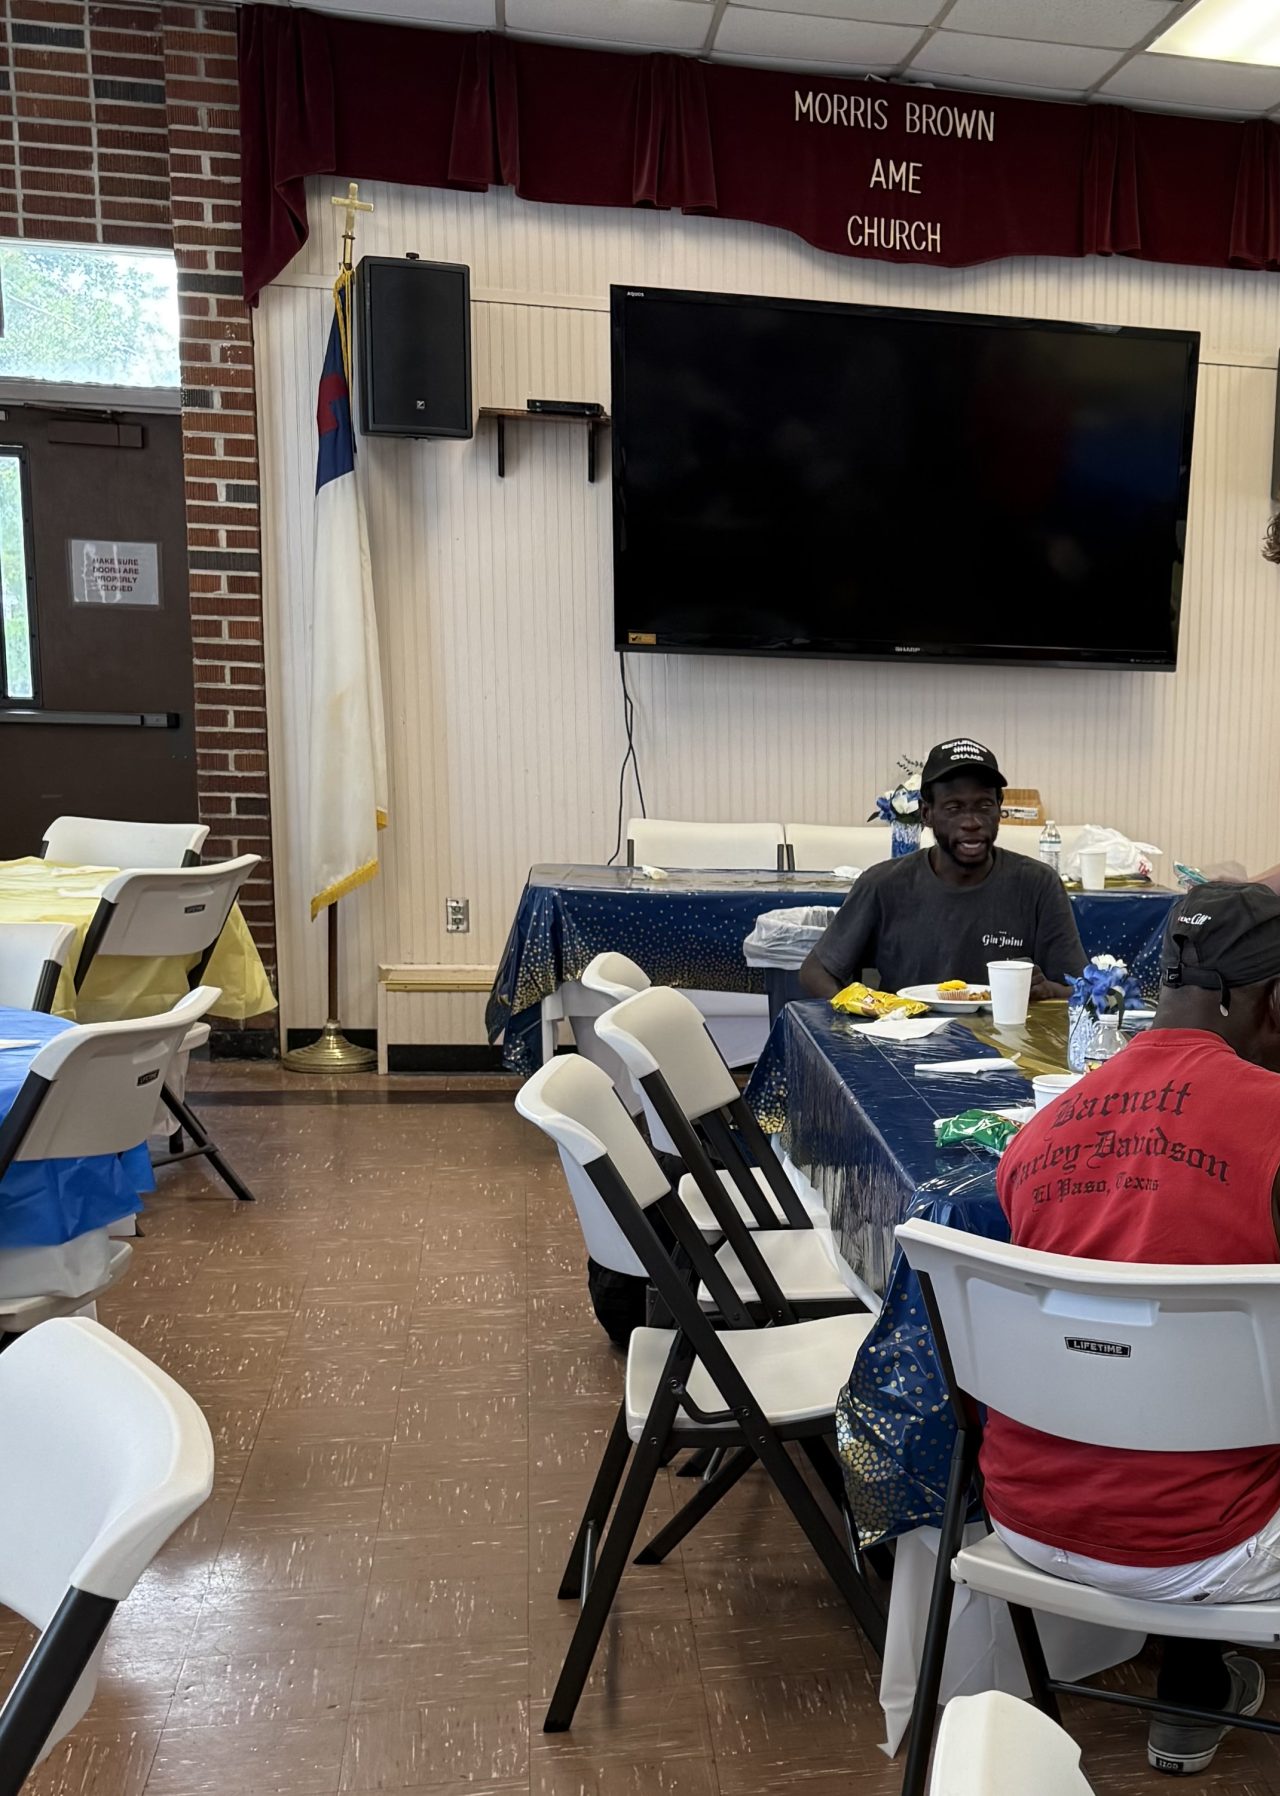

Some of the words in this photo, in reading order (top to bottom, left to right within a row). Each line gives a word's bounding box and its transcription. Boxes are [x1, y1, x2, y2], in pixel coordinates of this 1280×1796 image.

[794, 90, 889, 130] MORRIS
[905, 102, 995, 142] BROWN
[869, 158, 923, 194] AME
[847, 215, 941, 253] CHURCH
[122, 567, 140, 575] ARE
[1051, 1080, 1193, 1129] Barnett
[1073, 1340, 1123, 1354] LIFETIME
